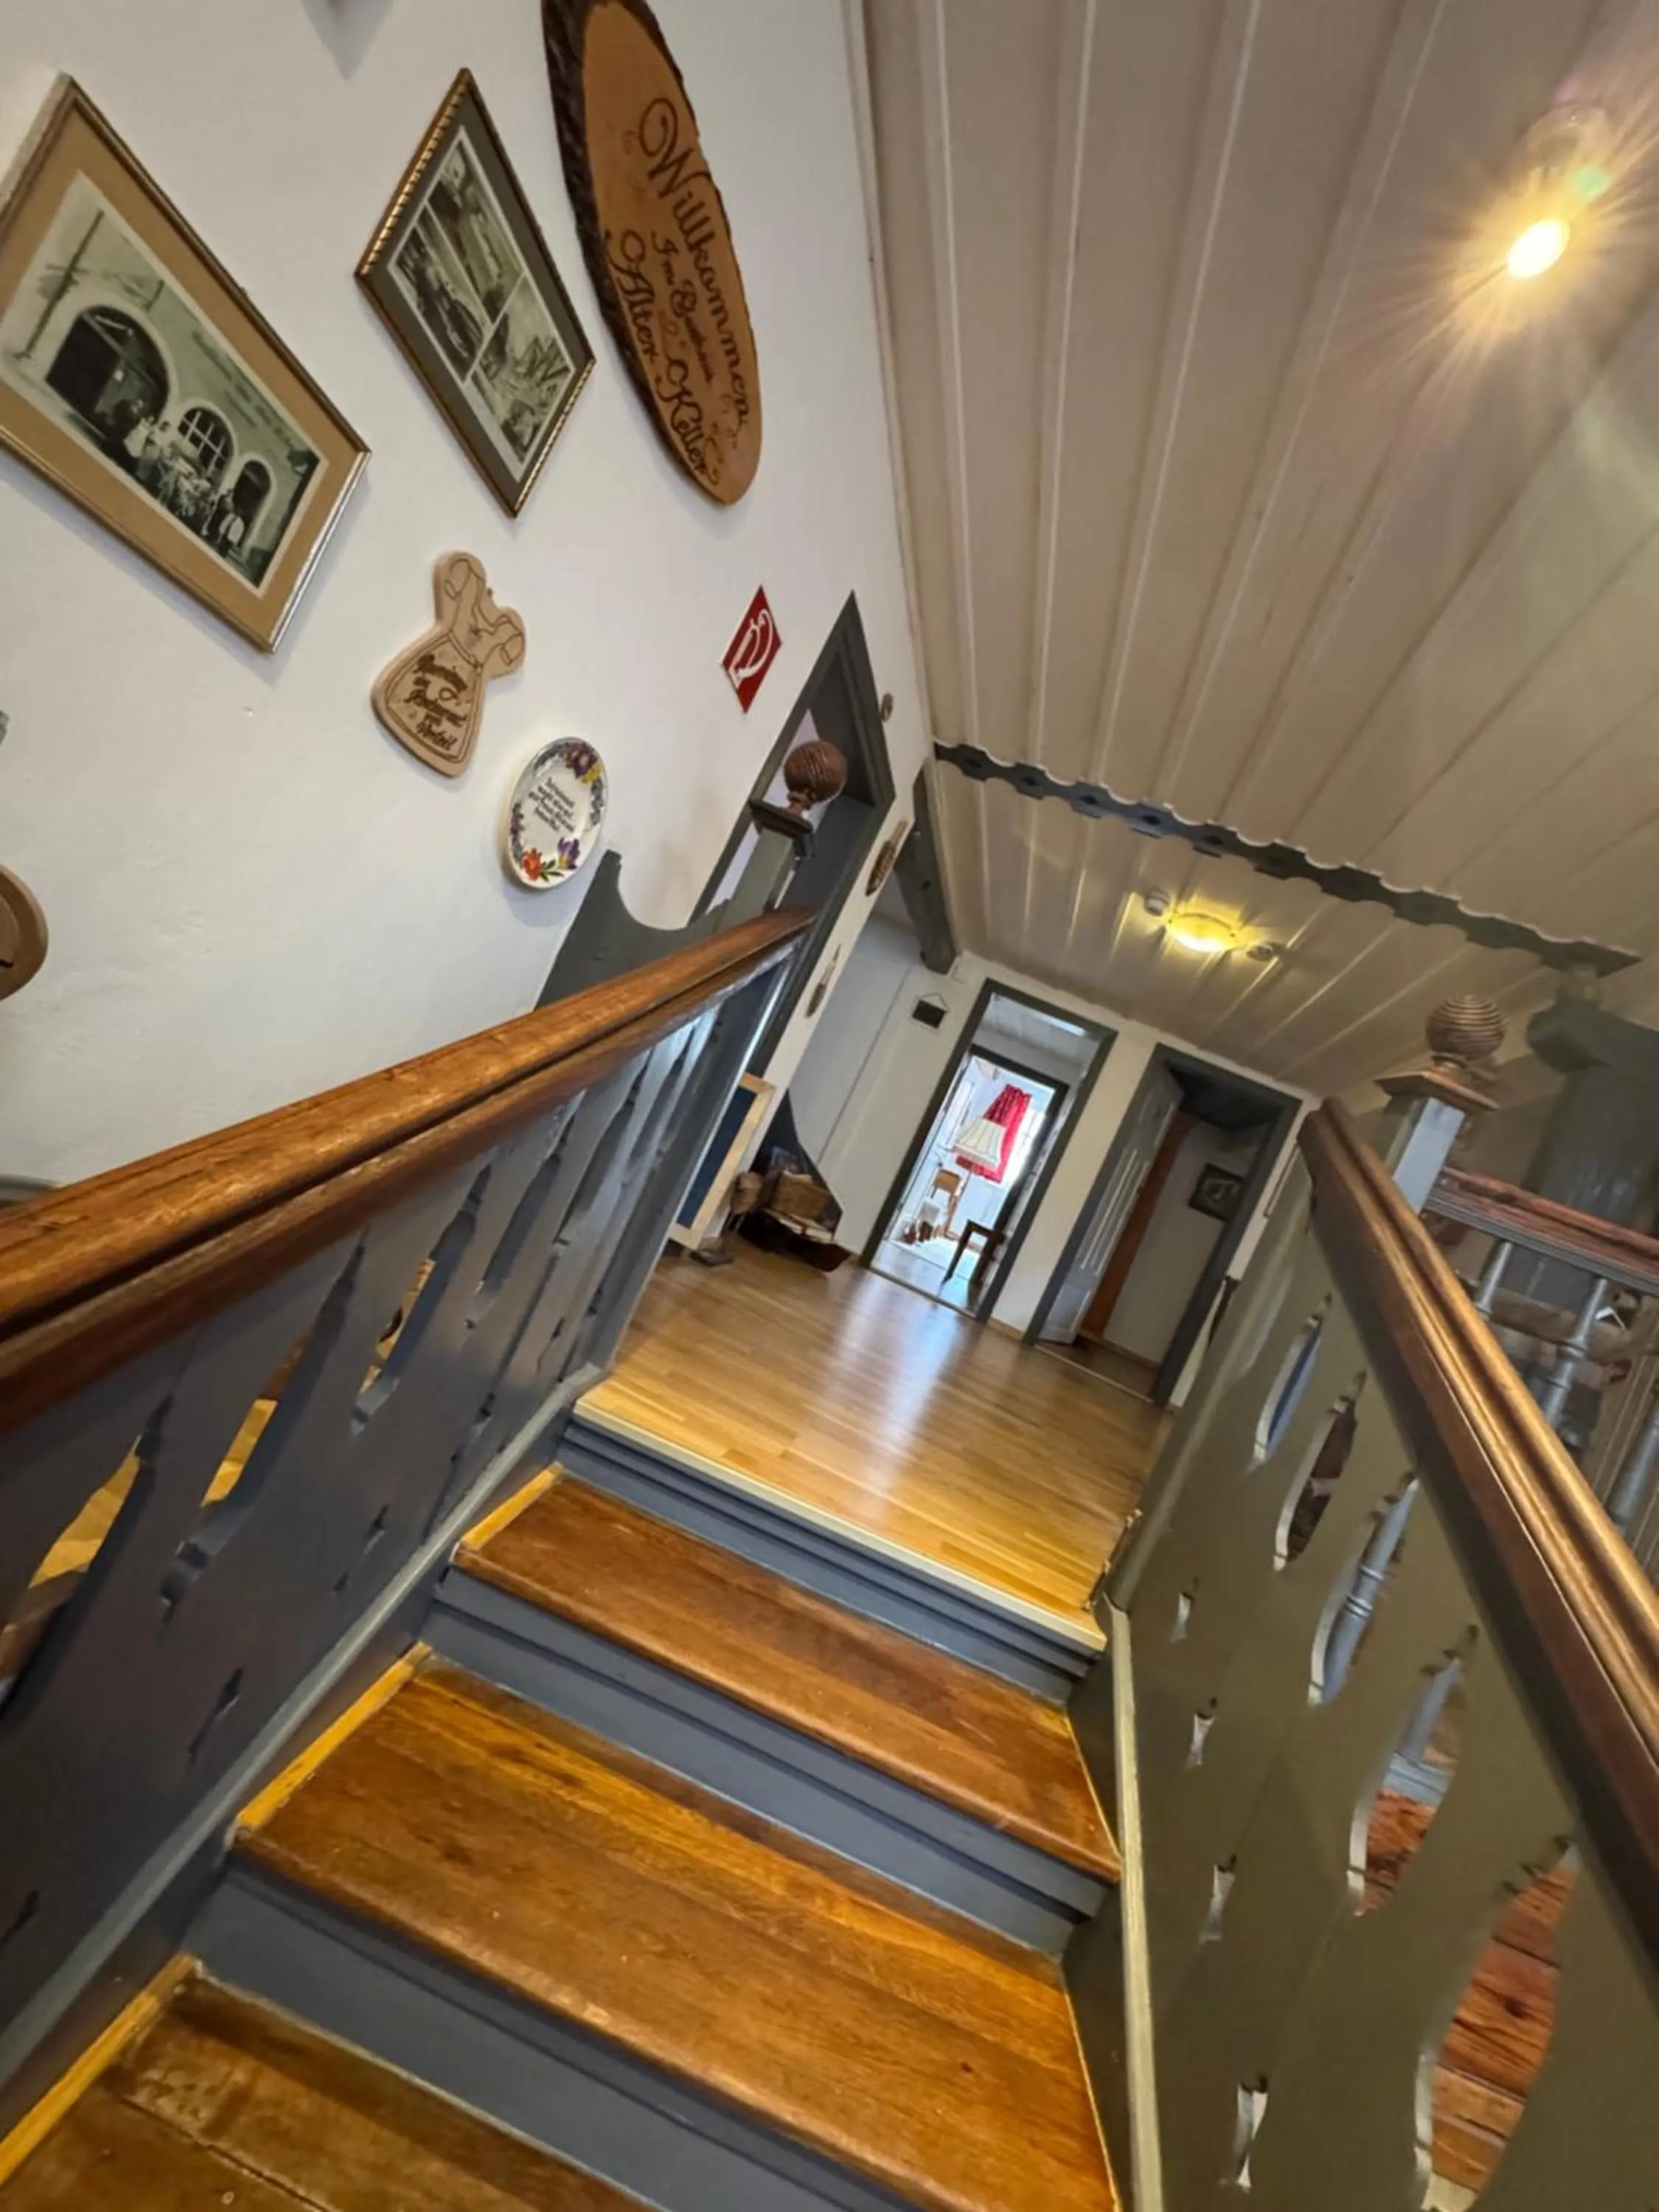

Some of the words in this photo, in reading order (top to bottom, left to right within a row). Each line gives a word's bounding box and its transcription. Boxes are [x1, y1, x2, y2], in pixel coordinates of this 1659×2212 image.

[606, 229, 658, 364] Alter
[655, 358, 707, 473] Keller
[639, 98, 748, 426] Willkommen
